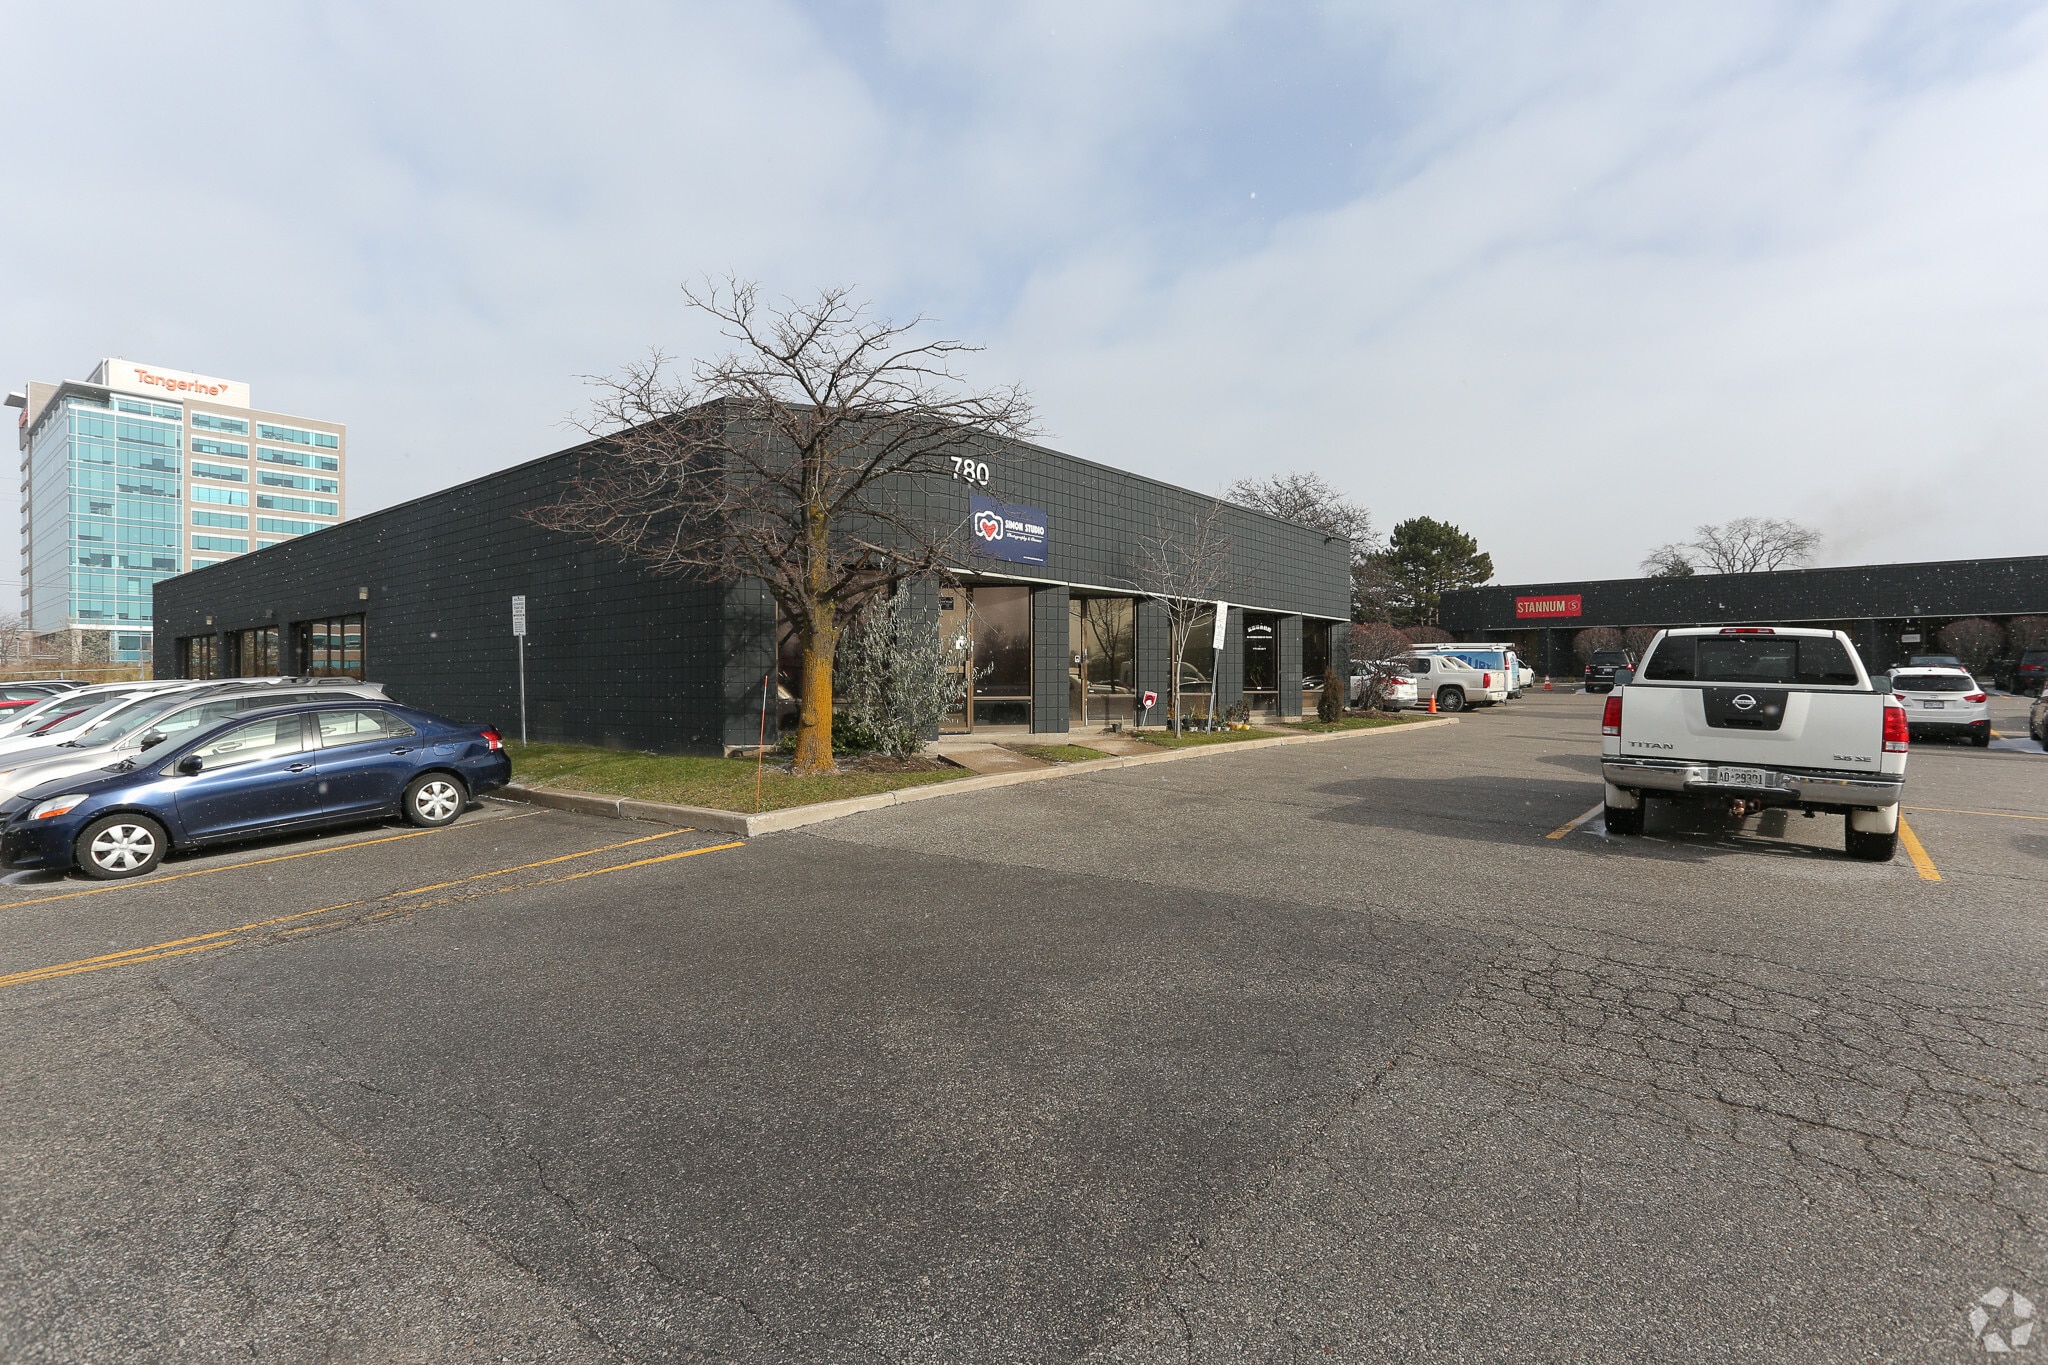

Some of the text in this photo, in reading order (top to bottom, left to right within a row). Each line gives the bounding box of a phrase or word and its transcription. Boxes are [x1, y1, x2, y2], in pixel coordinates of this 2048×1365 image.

[134, 368, 219, 396] Tangerine
[950, 455, 990, 486] 780
[1004, 519, 1045, 536] SIMON STUDIO
[1517, 600, 1566, 613] STANNUM
[1628, 740, 1674, 750] TITAN
